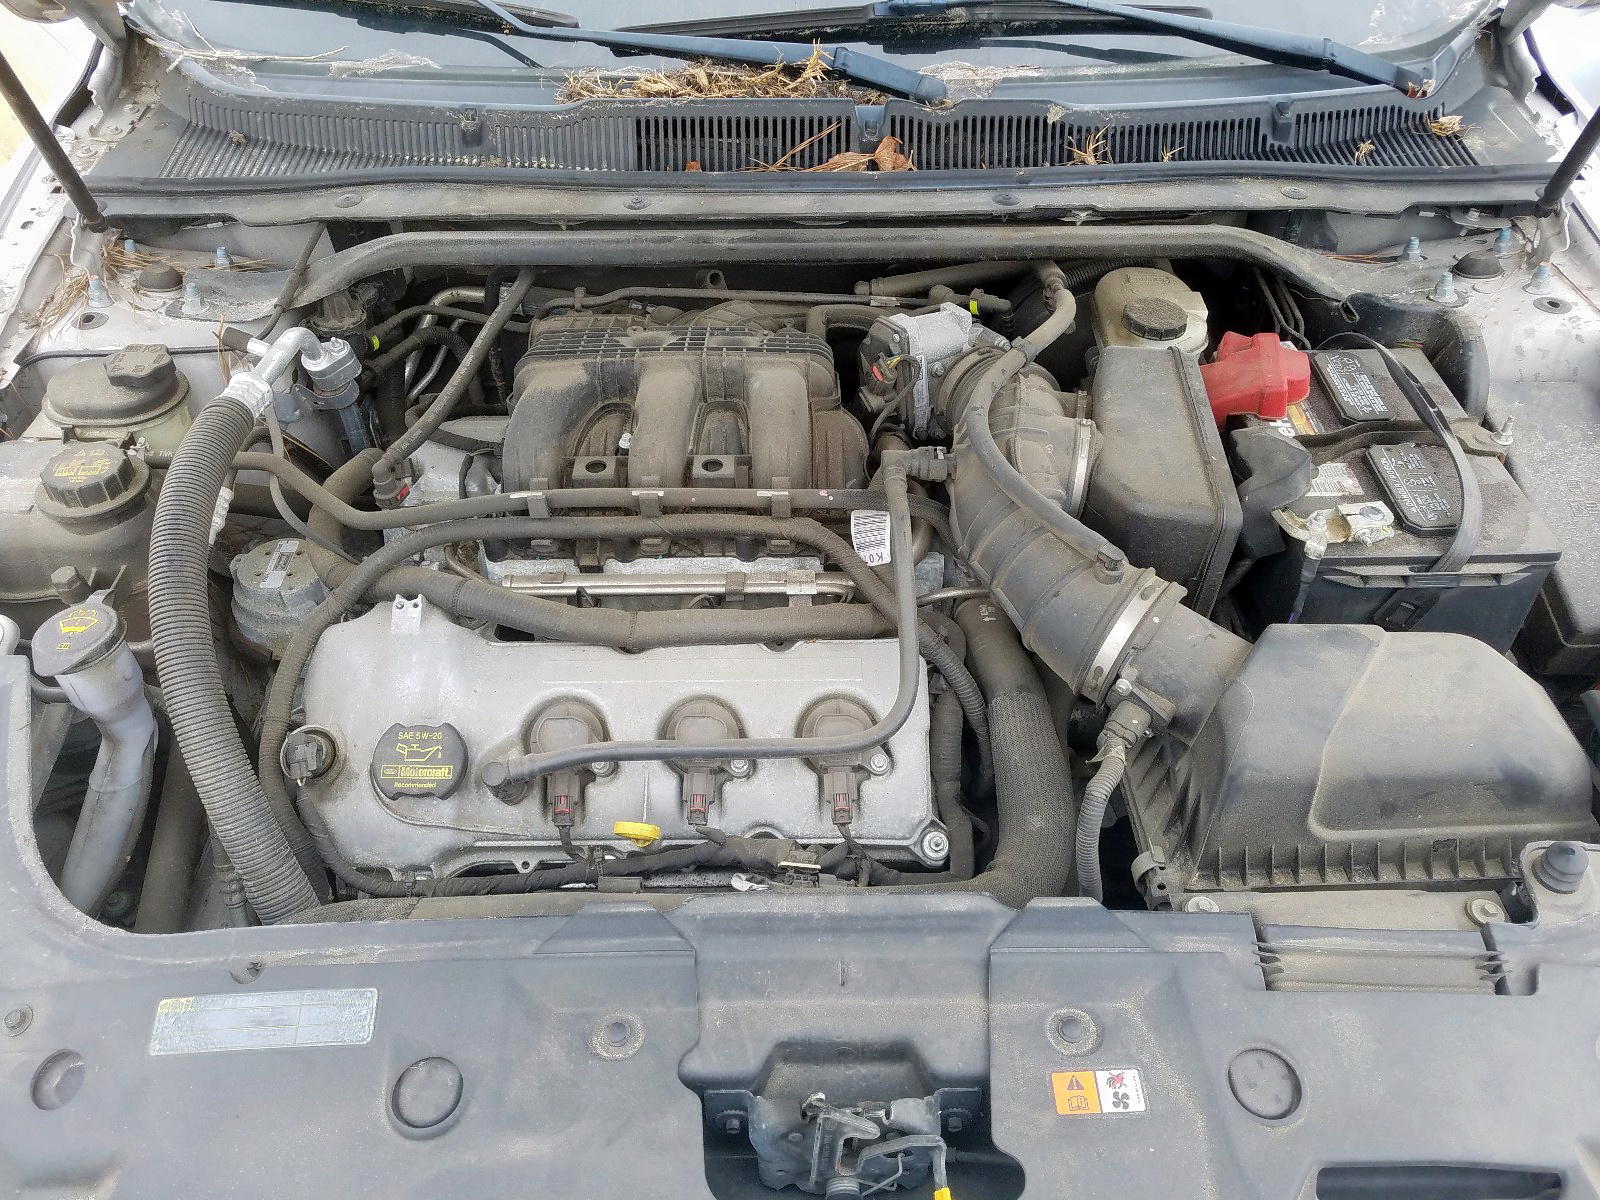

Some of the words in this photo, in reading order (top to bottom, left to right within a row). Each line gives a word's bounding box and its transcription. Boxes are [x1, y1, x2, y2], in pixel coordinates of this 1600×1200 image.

[398, 732, 414, 740] SAE
[415, 732, 442, 740] 5W-20
[401, 766, 449, 777] Motorcraft
